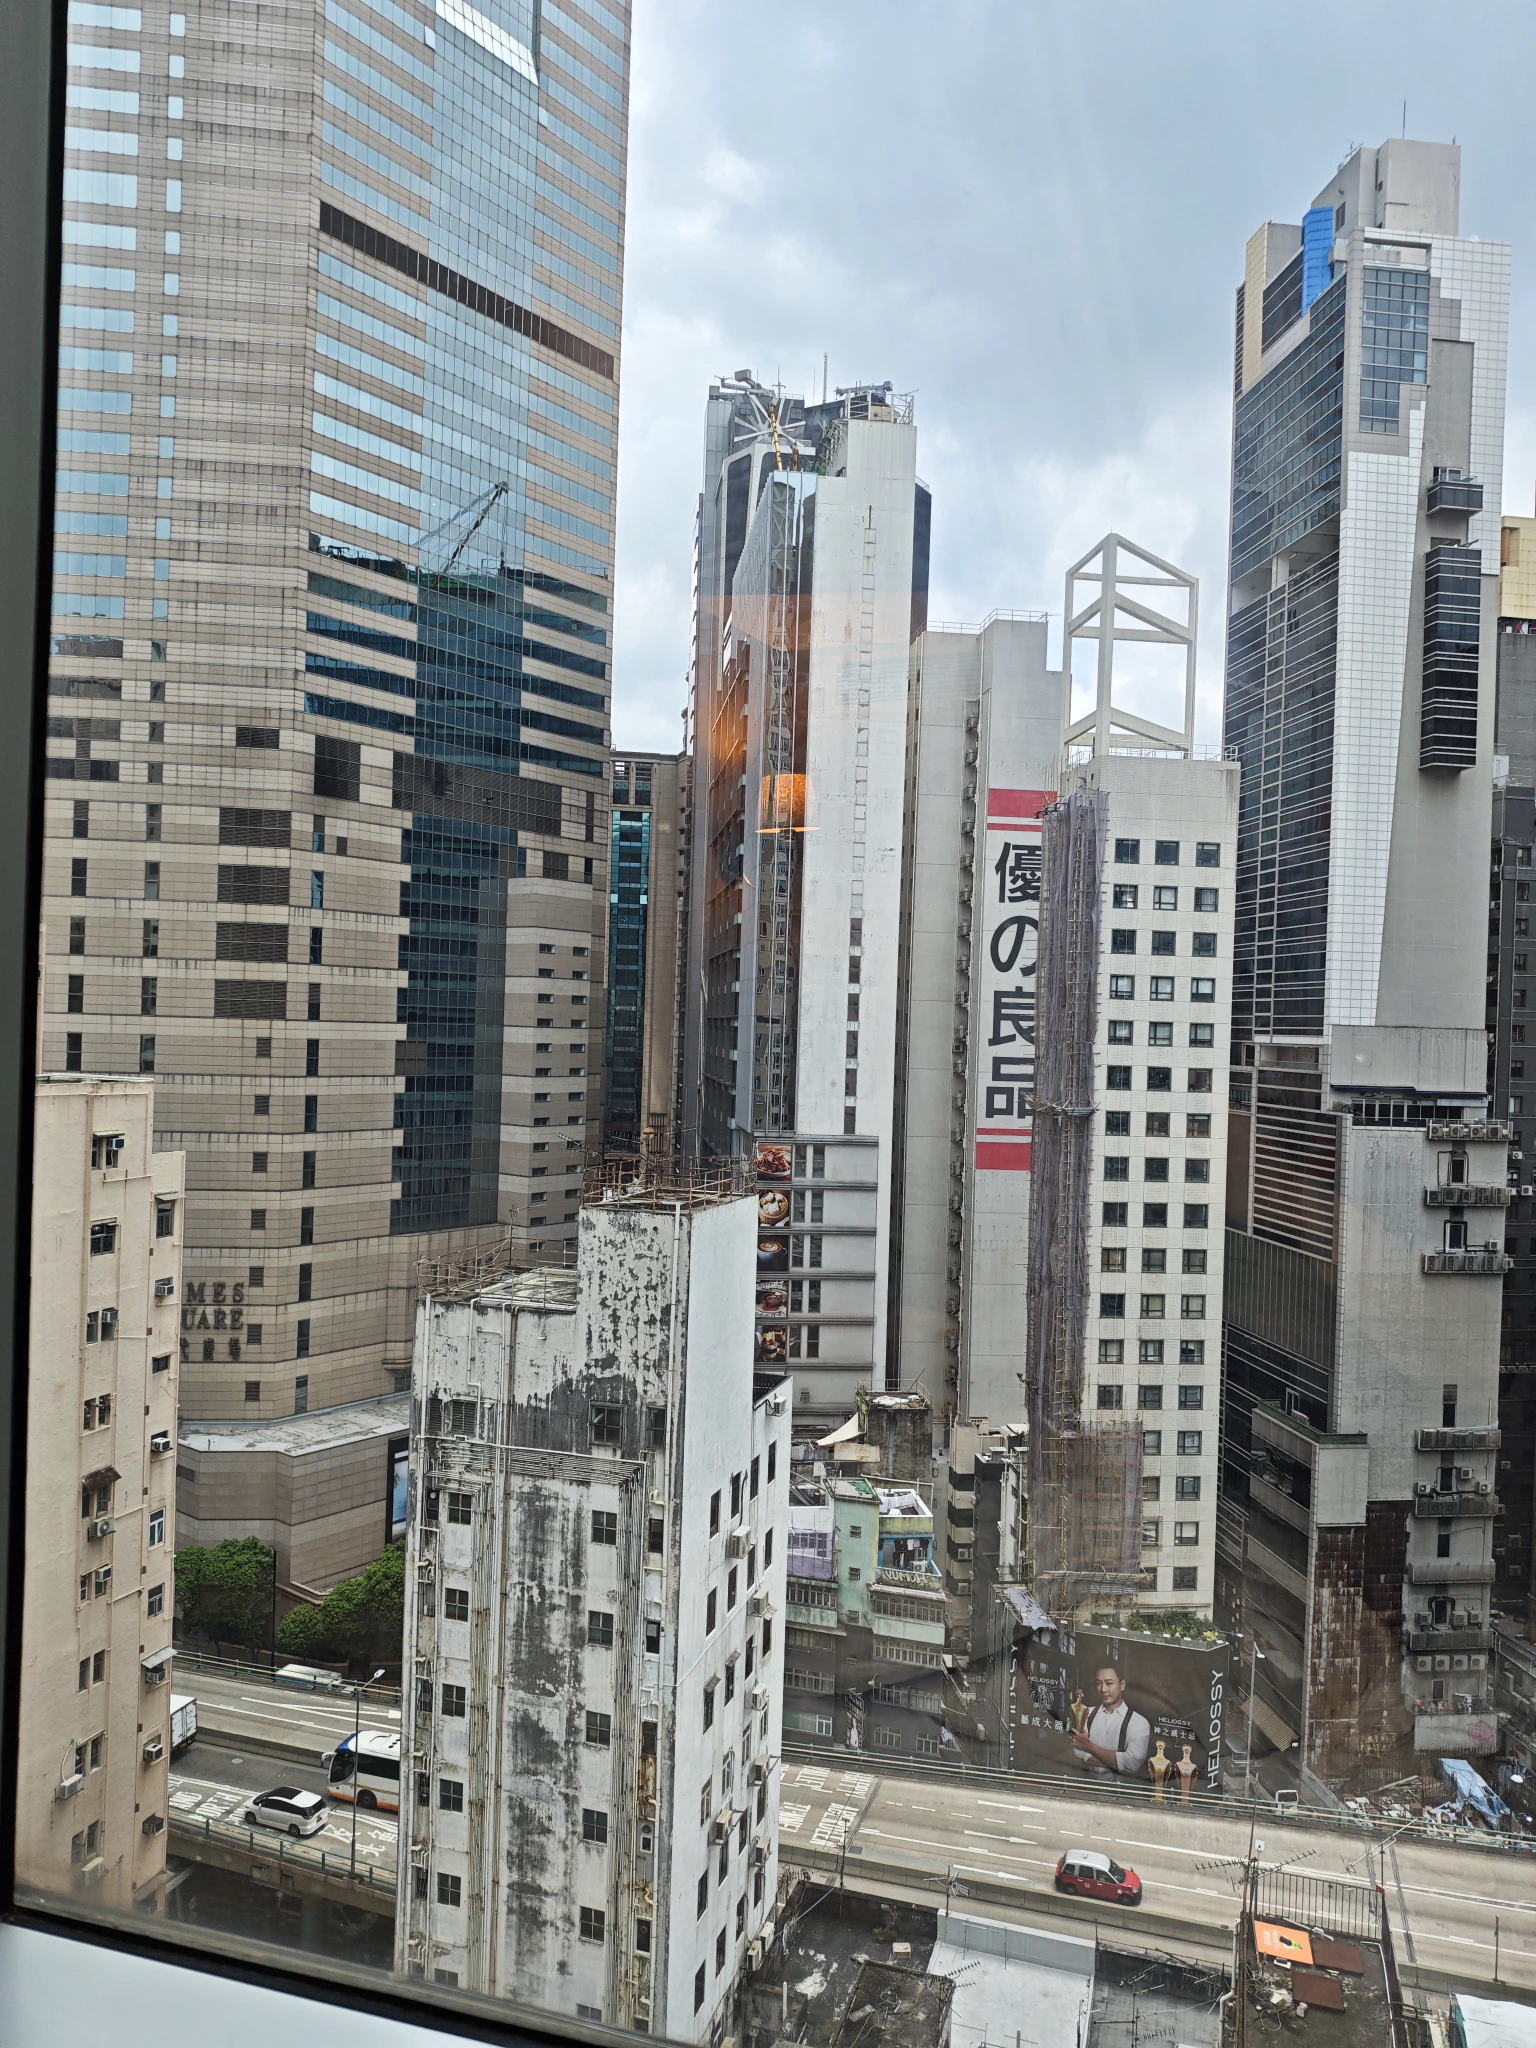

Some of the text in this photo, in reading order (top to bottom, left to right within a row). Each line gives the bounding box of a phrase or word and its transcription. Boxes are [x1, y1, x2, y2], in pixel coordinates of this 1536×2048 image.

[1027, 1675, 1060, 1686] HELIOSSY
[1158, 1716, 1192, 1727] HELIOSSY
[1153, 1725, 1196, 1741] 神之威士忌
[1207, 1669, 1224, 1790] HELIOSSY
